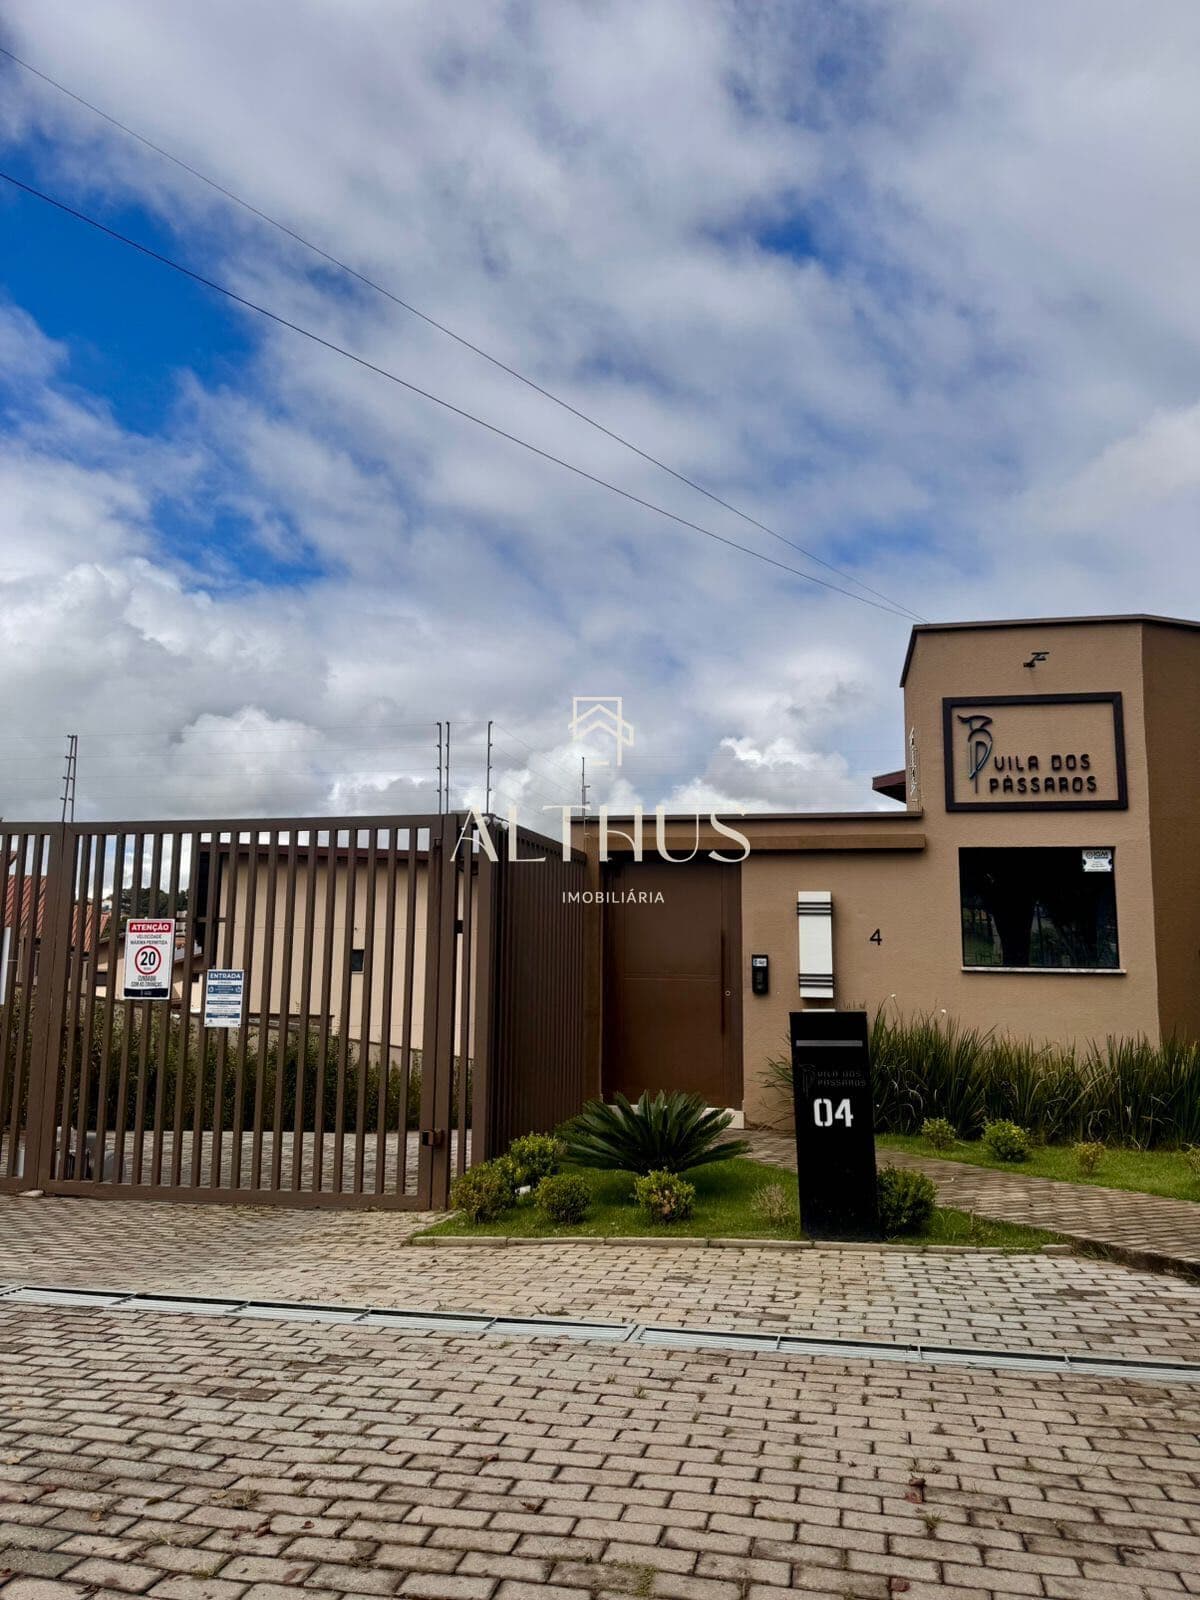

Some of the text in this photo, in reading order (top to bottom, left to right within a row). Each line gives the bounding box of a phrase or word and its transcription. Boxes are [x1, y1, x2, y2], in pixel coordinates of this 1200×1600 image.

[1051, 753, 1091, 771] DOS
[989, 775, 1098, 793] PÁSSAROS
[131, 923, 170, 932] ATENÇÃO
[869, 928, 883, 946] 4
[140, 951, 157, 966] 20
[813, 1098, 854, 1128] 04
